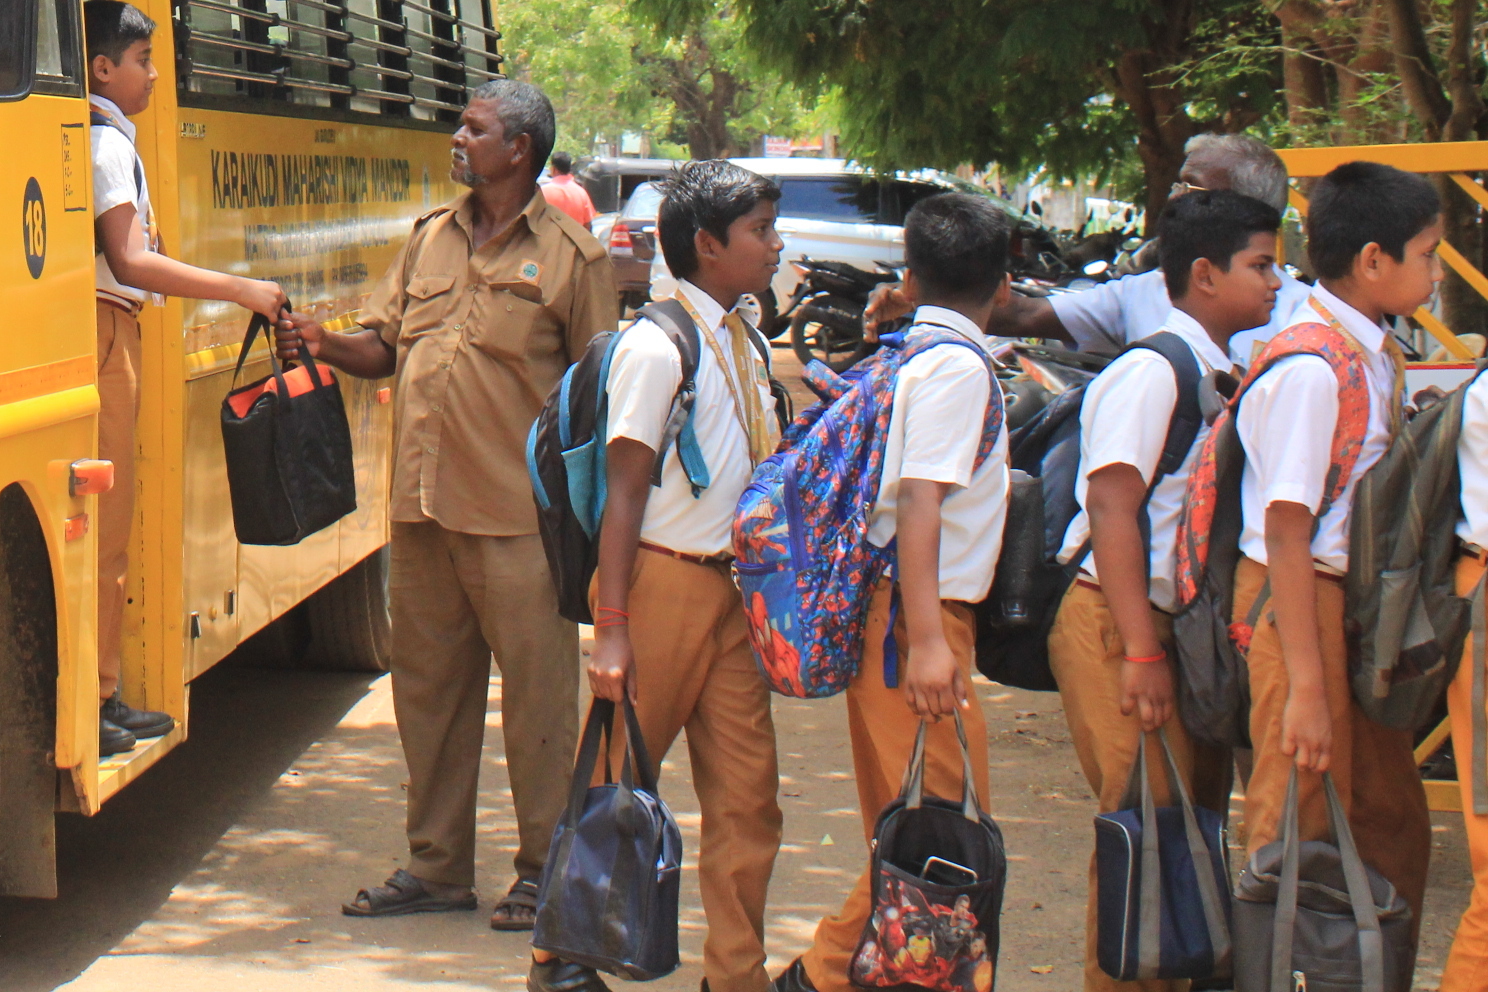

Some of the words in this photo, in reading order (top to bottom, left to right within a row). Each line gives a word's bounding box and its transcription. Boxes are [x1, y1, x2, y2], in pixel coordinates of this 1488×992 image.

[210, 149, 280, 209] KARAIKUDI
[281, 154, 340, 206] MAHARISHI
[24, 199, 44, 259] 18
